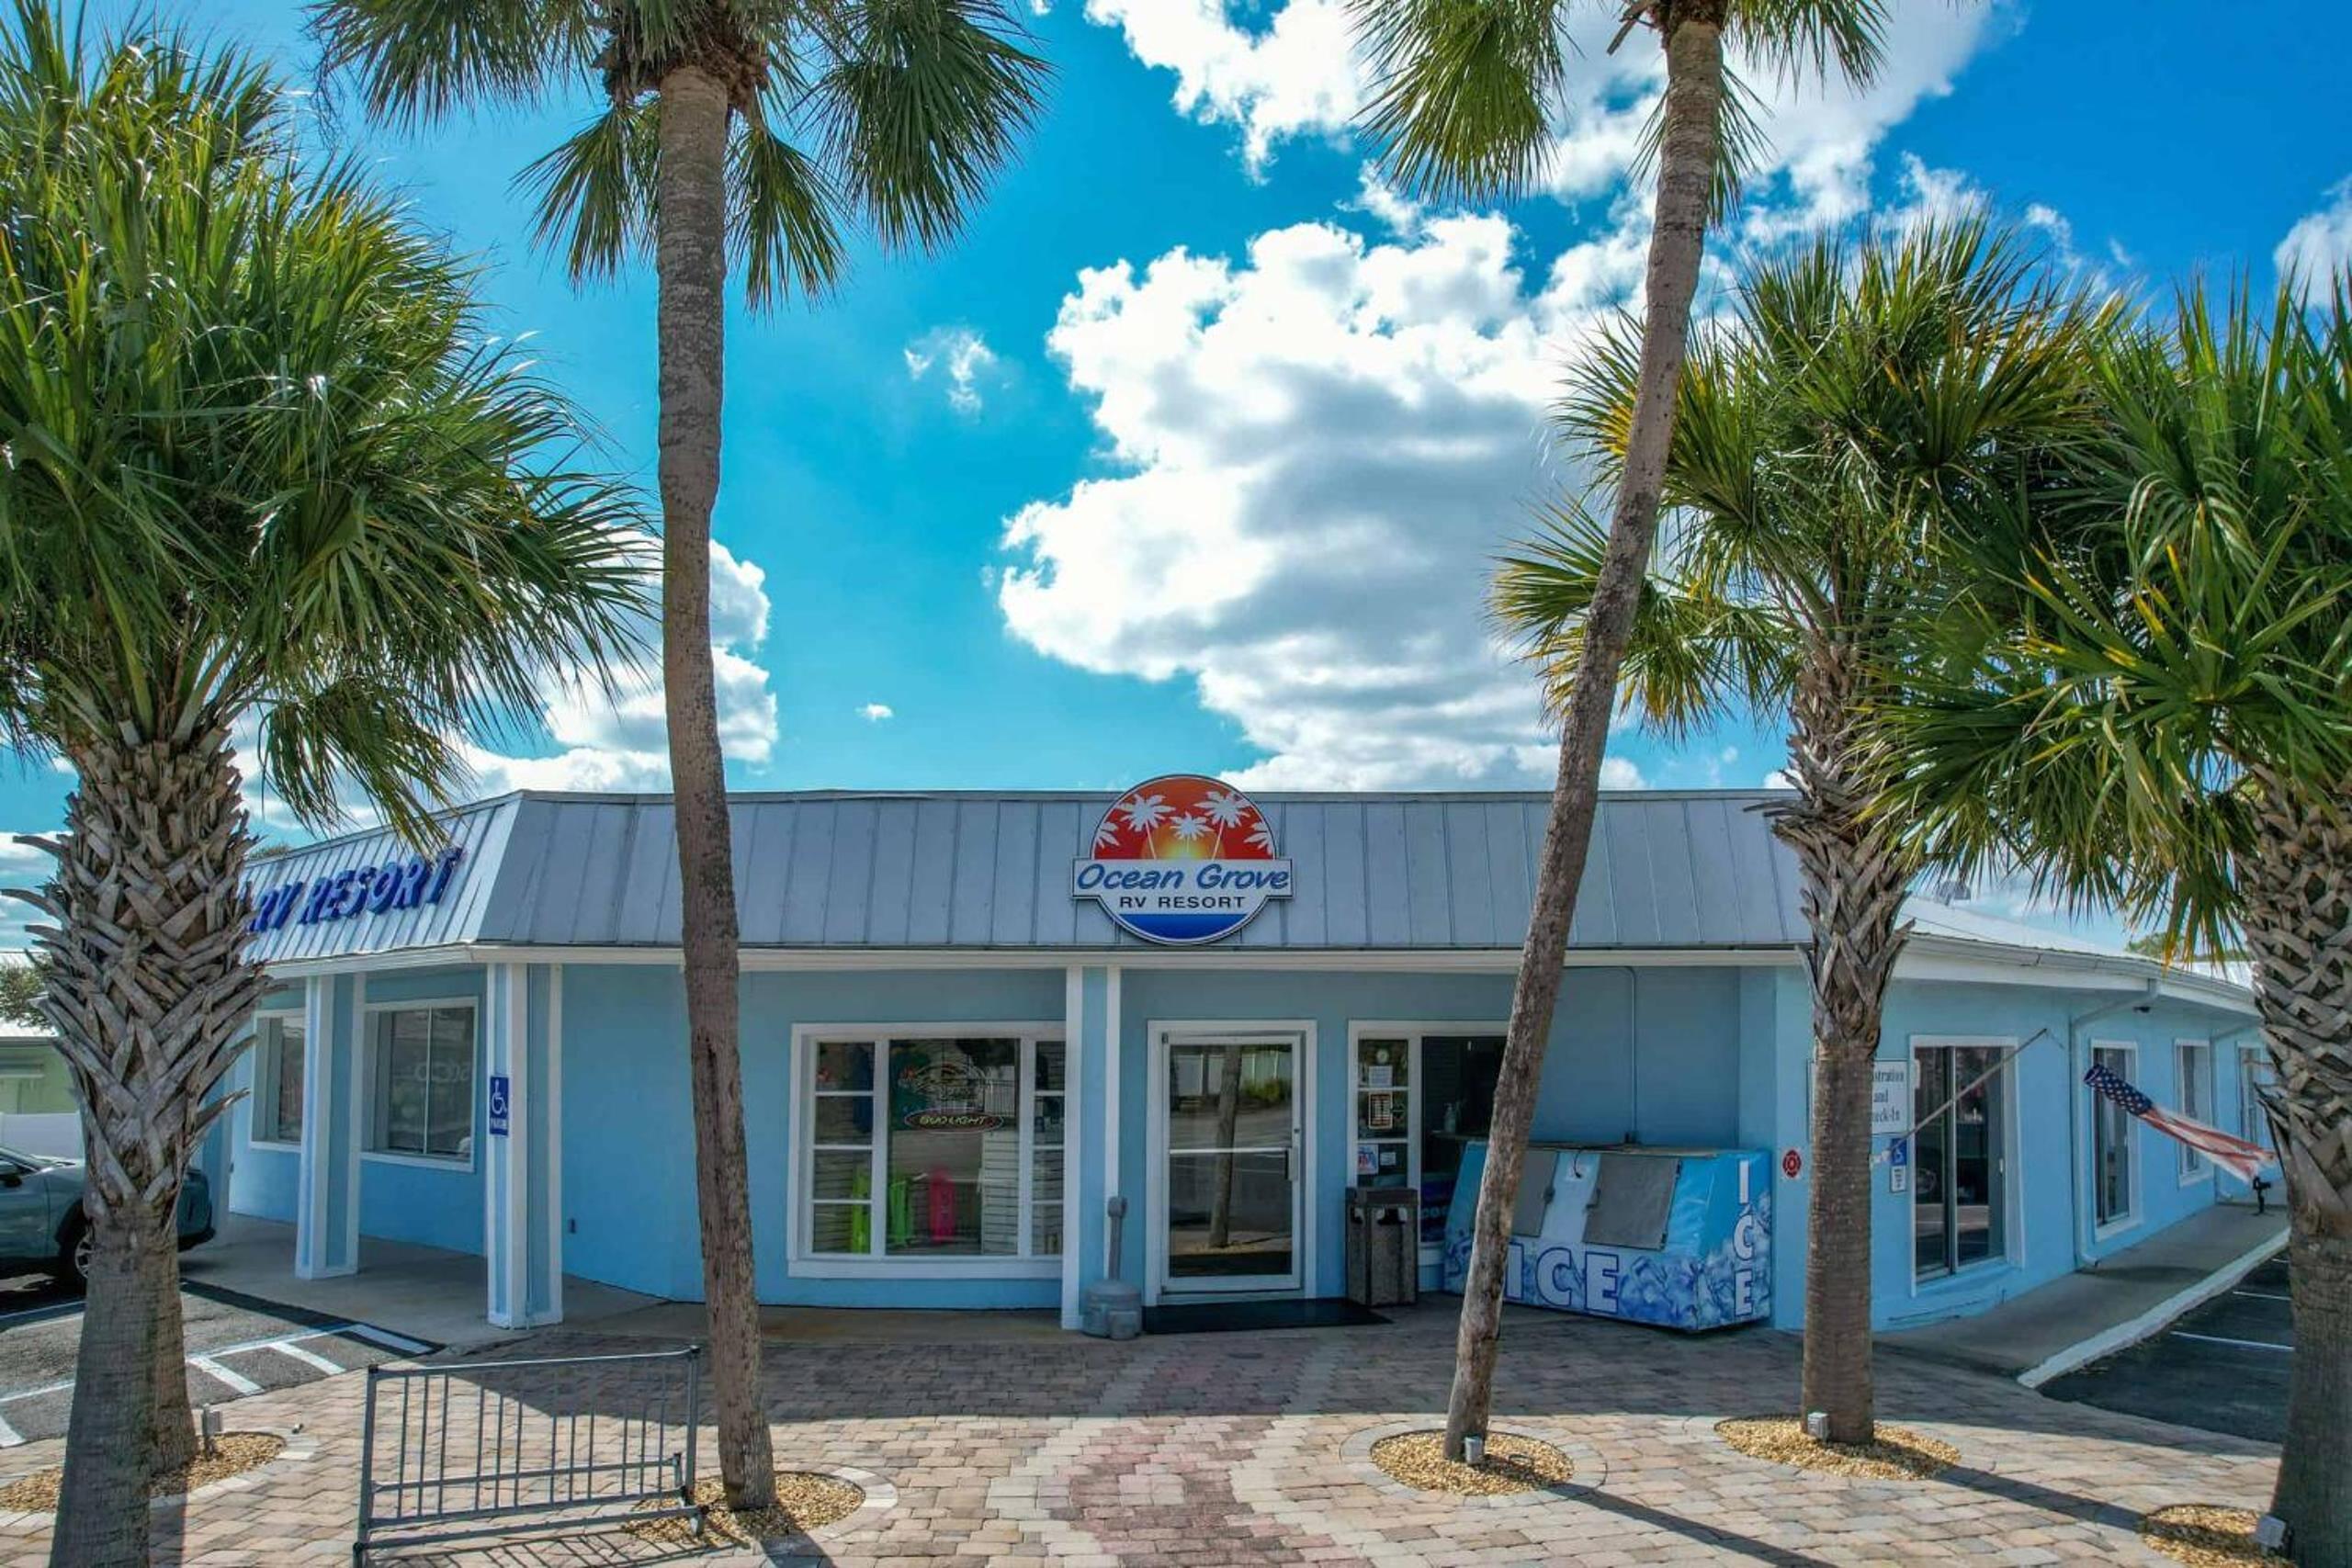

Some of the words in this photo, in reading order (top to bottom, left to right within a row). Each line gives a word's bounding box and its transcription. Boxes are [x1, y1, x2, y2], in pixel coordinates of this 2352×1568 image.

[250, 881, 304, 932] RV
[297, 847, 463, 924] RESORT
[1077, 863, 1185, 890] Ocean
[1196, 863, 1289, 890] Grove
[1119, 896, 1148, 909] RV
[1158, 896, 1246, 909] RESORT
[1733, 1159, 1754, 1318] ICE
[1505, 1241, 1620, 1314] ICE
